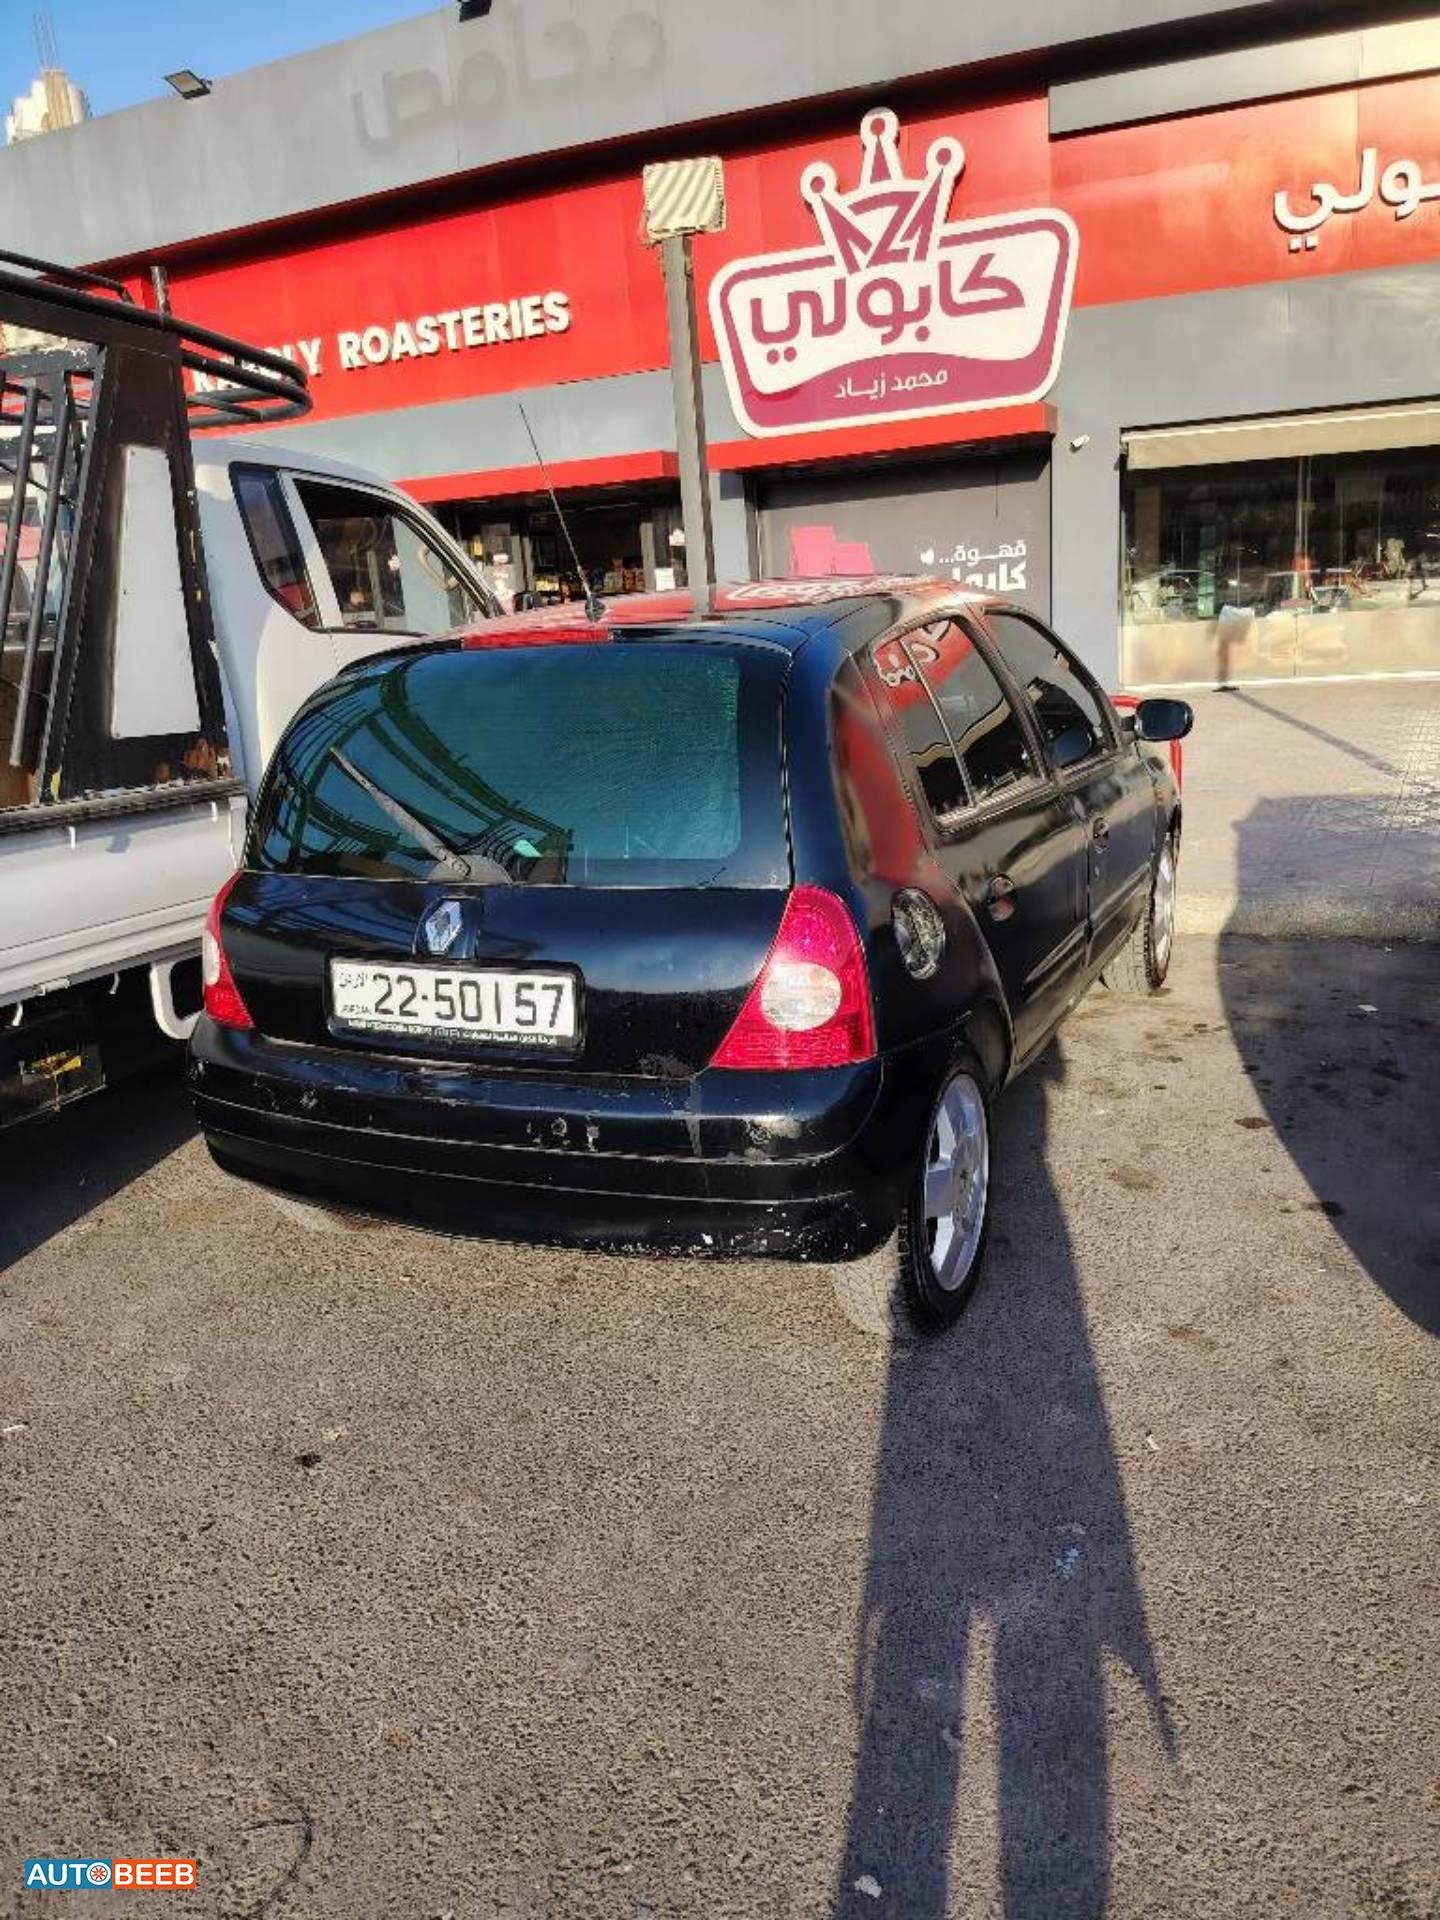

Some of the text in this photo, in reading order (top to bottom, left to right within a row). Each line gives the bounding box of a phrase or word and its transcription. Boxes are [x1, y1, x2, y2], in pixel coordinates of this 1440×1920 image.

[1273, 147, 1440, 252] ولي
[338, 291, 571, 369] ROASTERIES
[750, 253, 1026, 365] كابولي
[834, 369, 948, 400] محمد زياد
